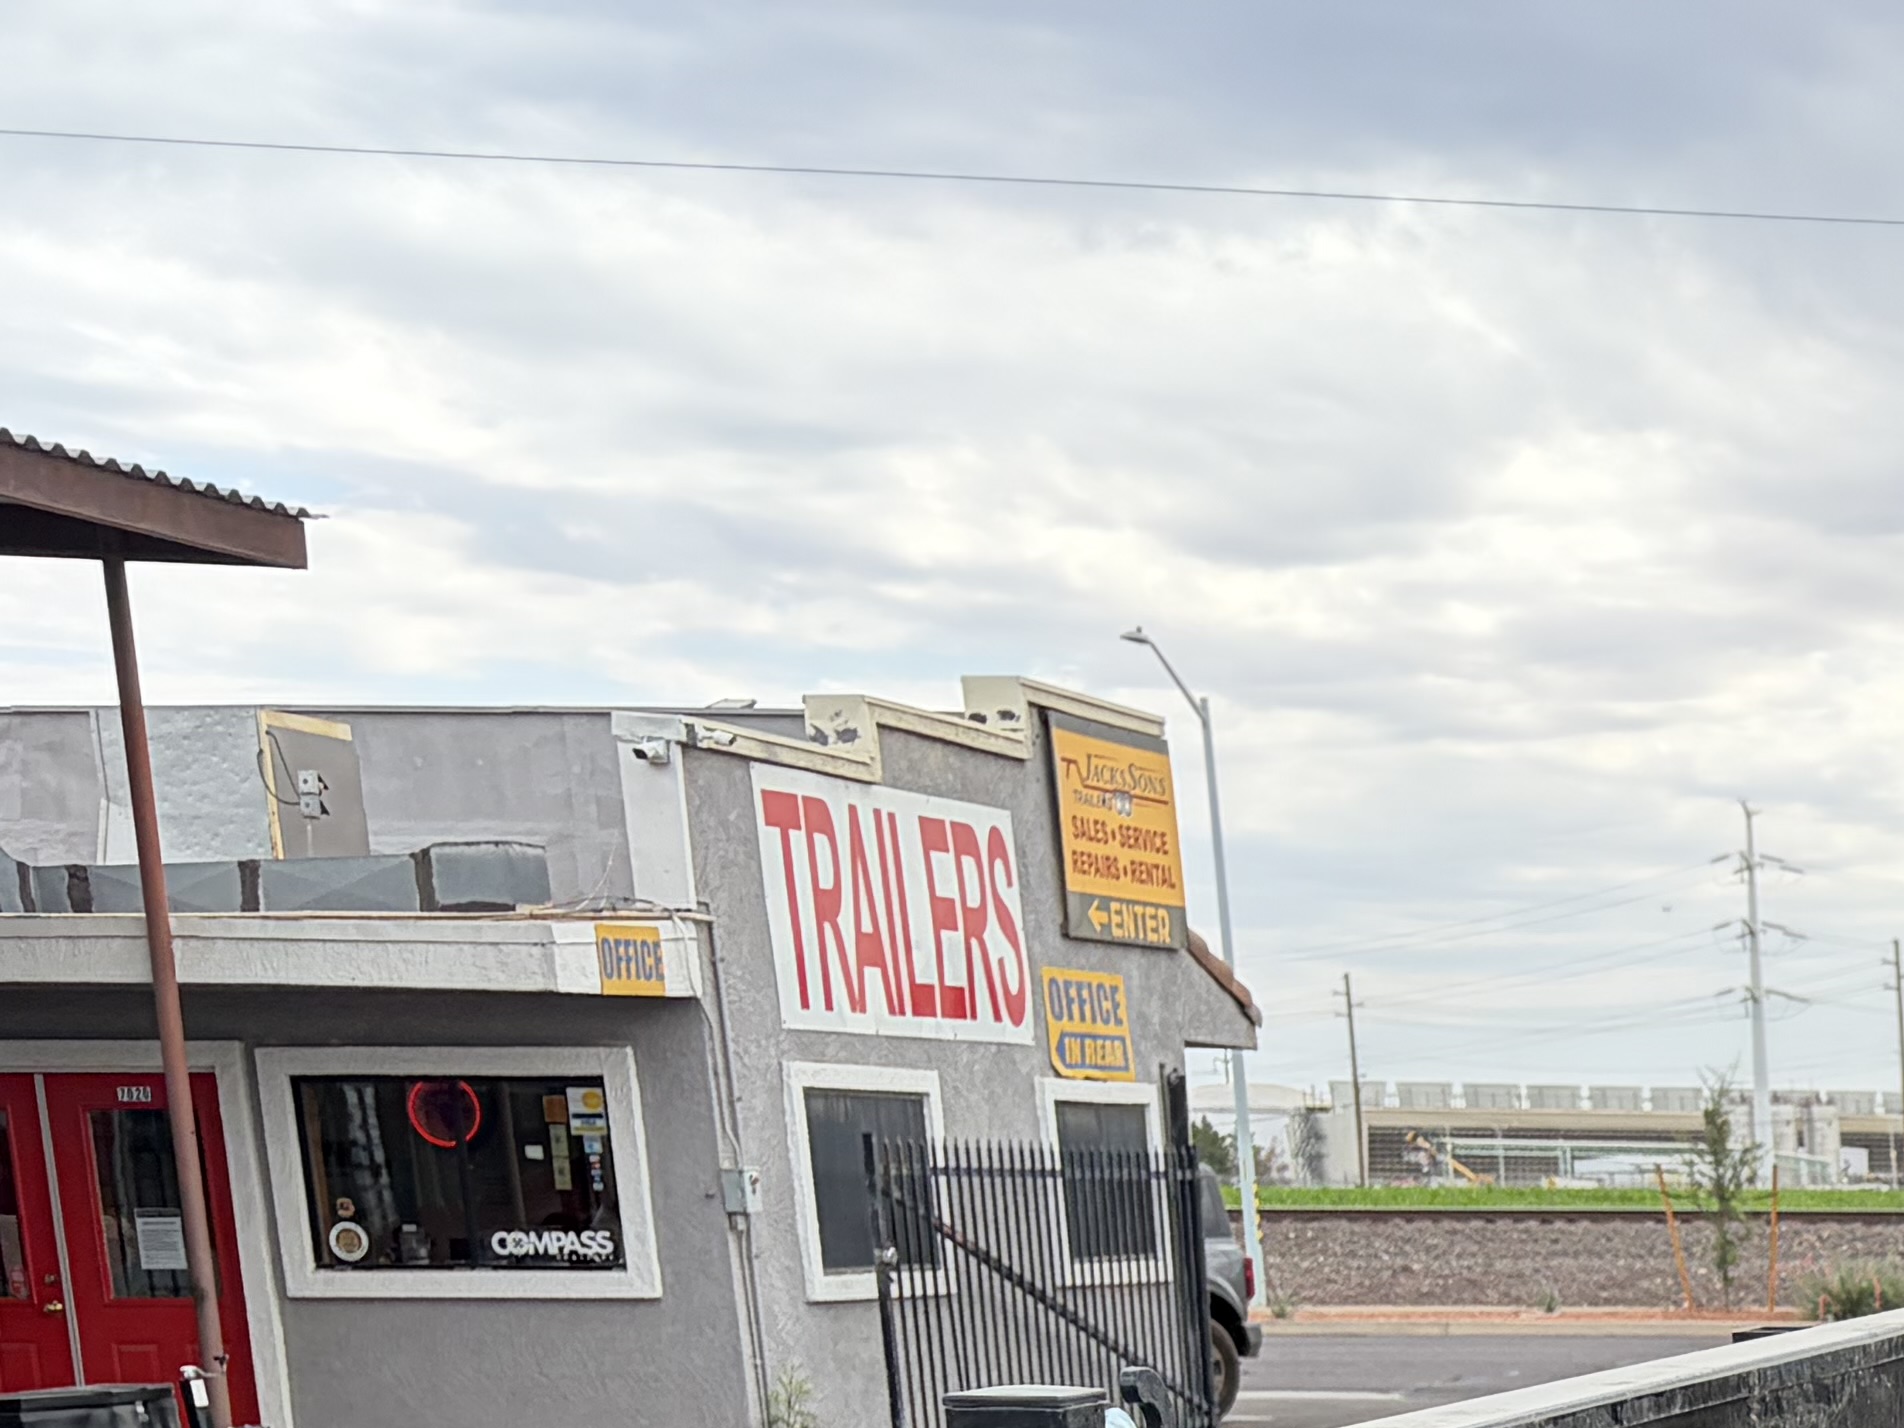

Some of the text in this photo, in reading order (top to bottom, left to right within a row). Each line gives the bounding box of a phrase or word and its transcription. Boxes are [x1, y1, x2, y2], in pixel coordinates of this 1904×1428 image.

[1071, 815, 1169, 855] SALES SERVICE
[1071, 850, 1176, 889] REPAIRS RENTAL
[760, 788, 1026, 1028] TRAILERS
[1110, 901, 1171, 944] ENTER
[601, 937, 665, 981] OFFICE
[1048, 977, 1124, 1027] OFFICE
[491, 1230, 614, 1257] COMPASS
